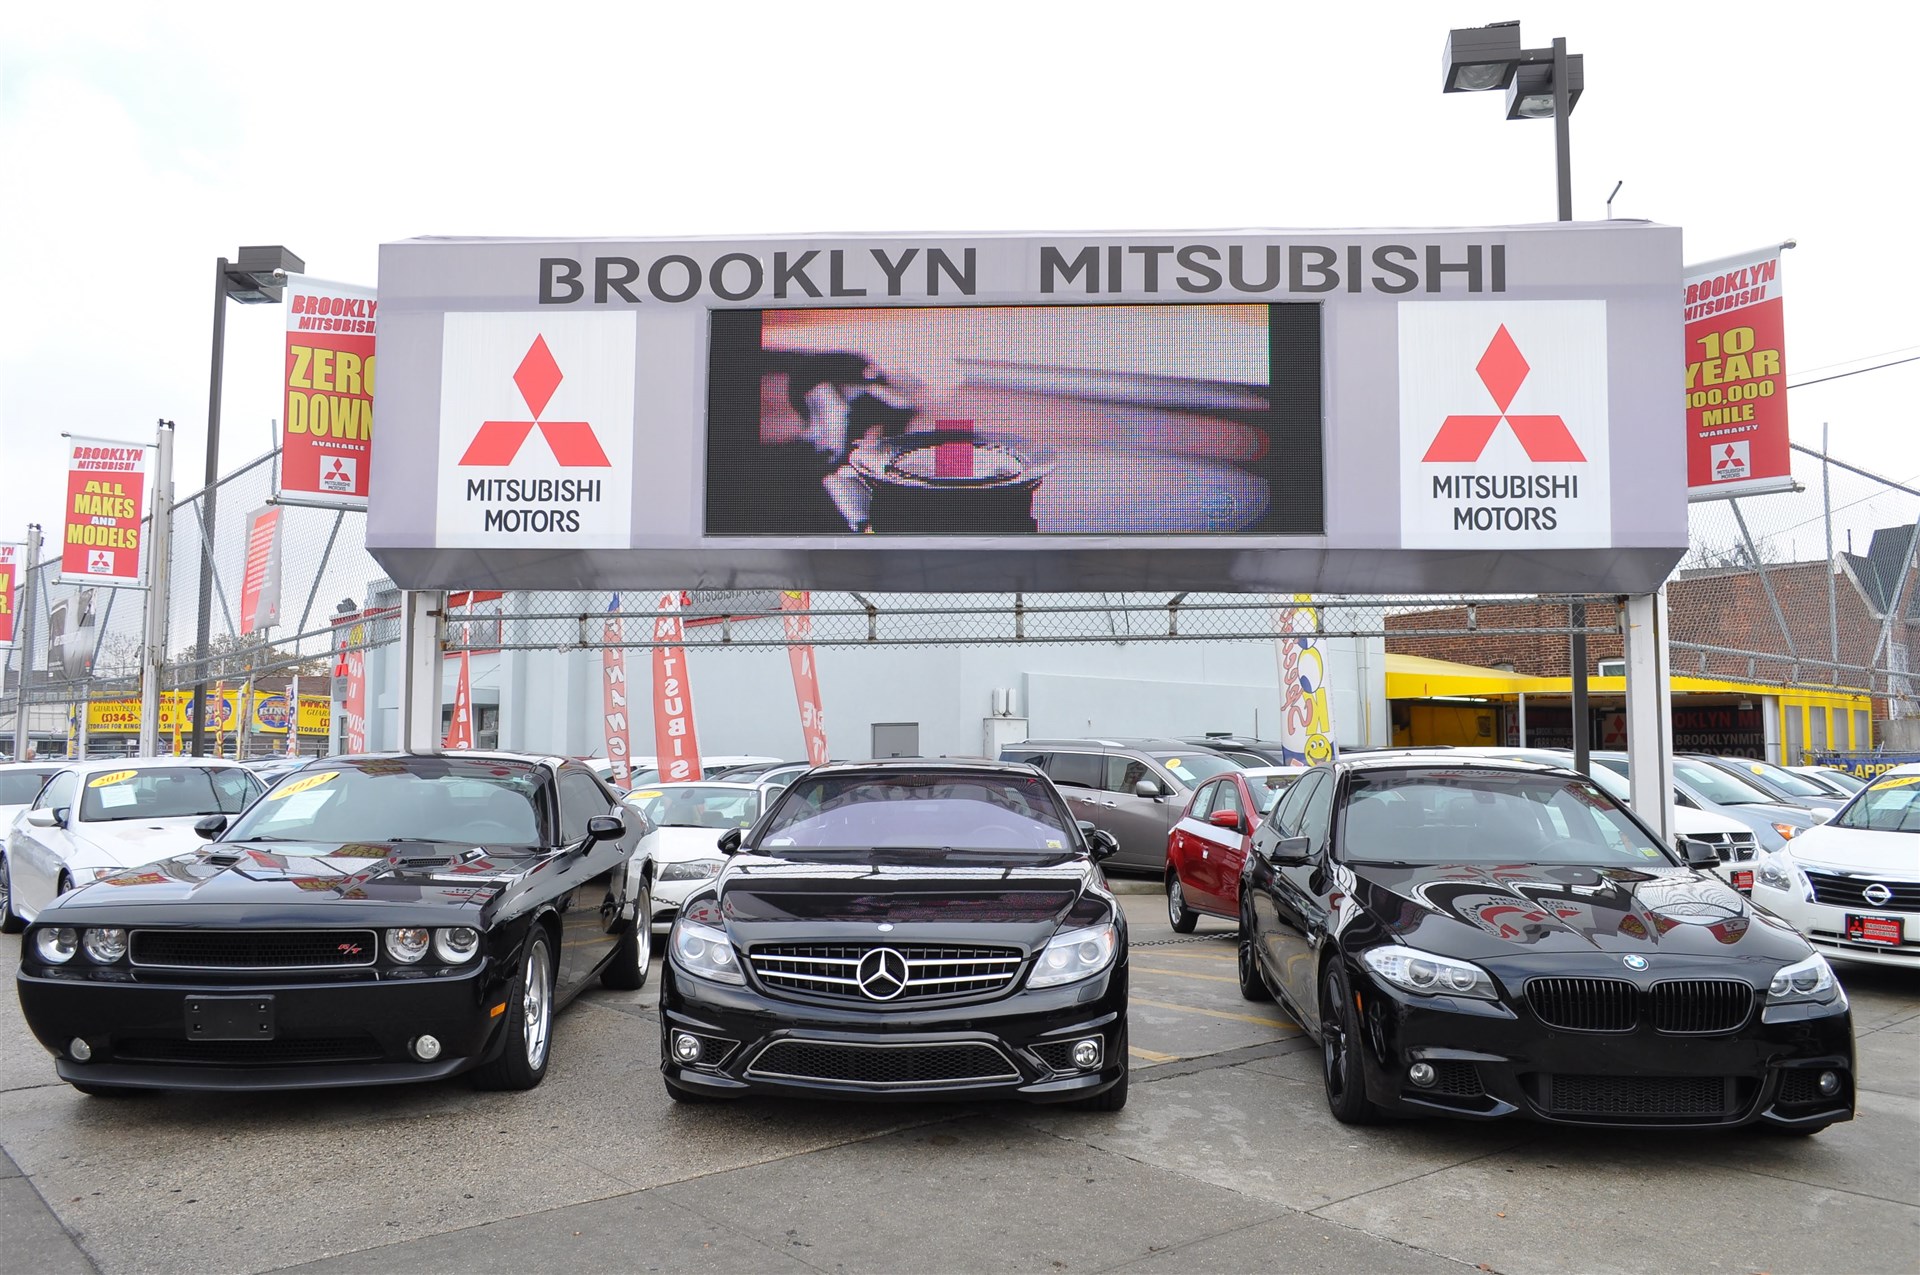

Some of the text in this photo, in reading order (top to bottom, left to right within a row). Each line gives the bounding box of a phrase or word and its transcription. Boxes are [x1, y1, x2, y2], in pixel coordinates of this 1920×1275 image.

[538, 244, 1506, 305] BROOKLYN MITSUBISHI
[291, 295, 377, 318] BROOKLY
[1684, 285, 1766, 321] MITSUBISHI
[298, 317, 376, 334] MITSUBISH
[1697, 326, 1755, 359] 10
[1685, 349, 1780, 389] YEAR
[1686, 380, 1774, 410] 100,000
[1702, 404, 1755, 427] MILE
[1699, 424, 1759, 438] WARRANTY
[73, 446, 143, 462] BROOKLYN
[312, 440, 365, 451] AVAILABLE
[77, 461, 135, 471] MITSUBISHI
[84, 480, 126, 496] ALL
[466, 478, 602, 503] MITSUBISHI
[1432, 474, 1579, 499] MITSUBISHI
[74, 493, 135, 519] MAKES
[1453, 506, 1557, 531] MOTORS
[90, 516, 117, 527] AND
[484, 508, 580, 533] MOTORS
[67, 523, 138, 550] MODELS
[337, 943, 362, 955] R/T
